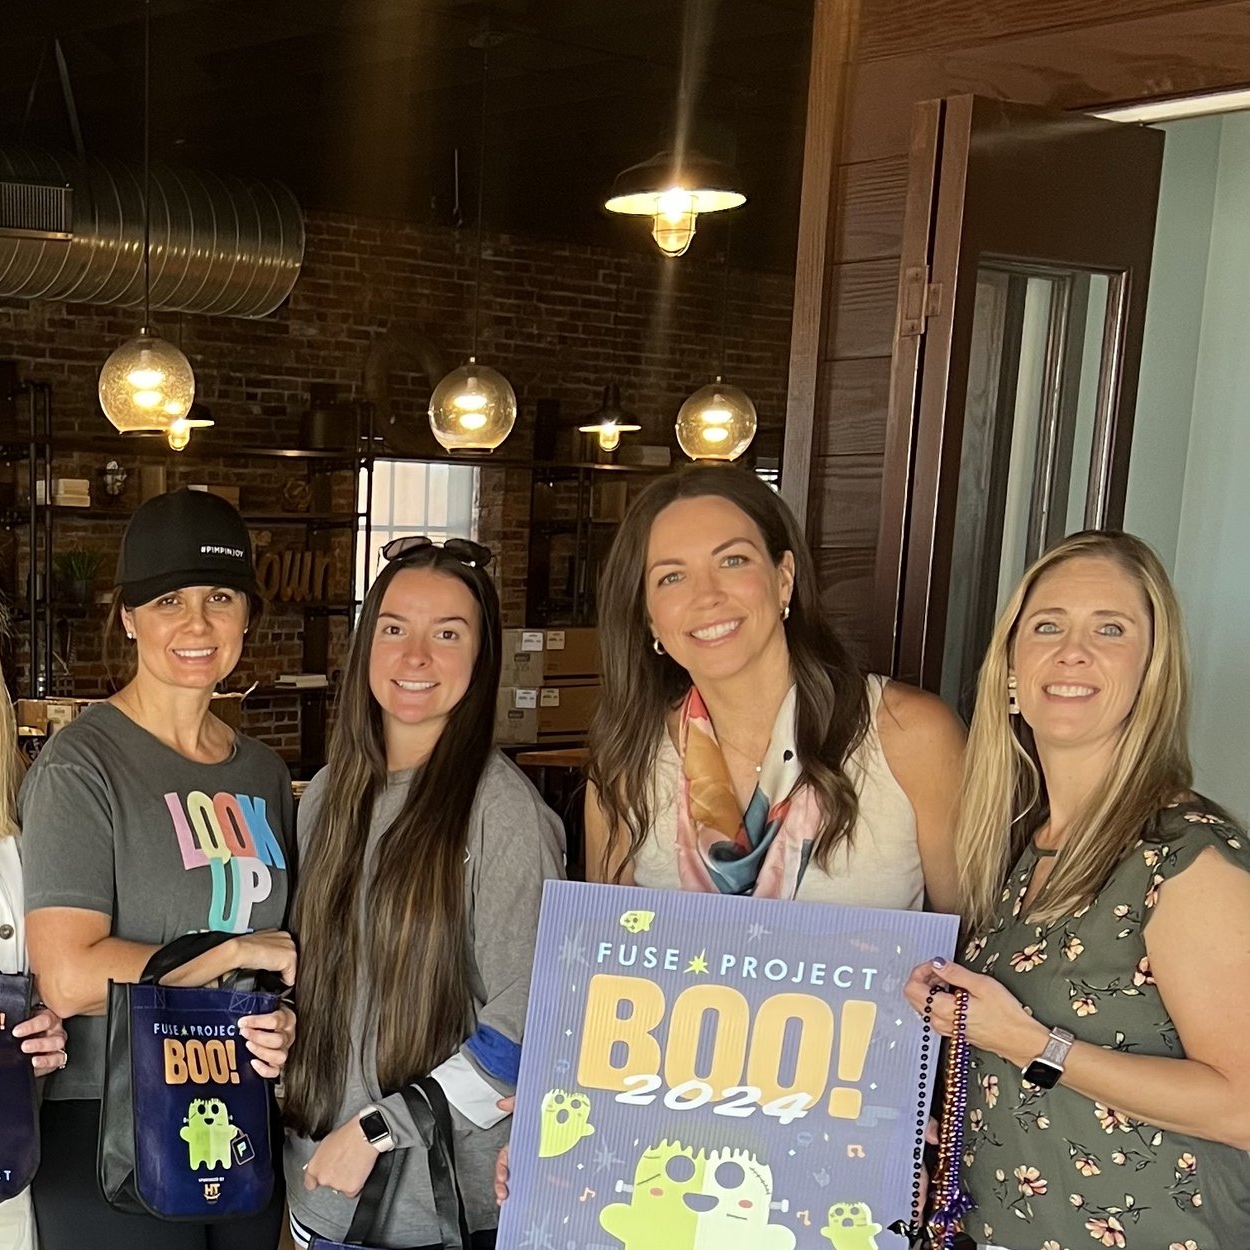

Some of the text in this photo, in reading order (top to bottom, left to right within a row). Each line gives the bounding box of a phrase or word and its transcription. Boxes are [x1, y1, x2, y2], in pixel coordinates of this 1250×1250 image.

[200, 545, 245, 558] #PIMPINJOY
[251, 533, 336, 602] own
[164, 790, 286, 870] LOOK
[209, 857, 272, 933] UP
[597, 941, 878, 991] FUSE PROJECT
[153, 1022, 241, 1037] FUSE PROJEC
[577, 973, 878, 1120] BOO!
[163, 1038, 240, 1085] BOO!
[614, 1073, 815, 1124] 2024
